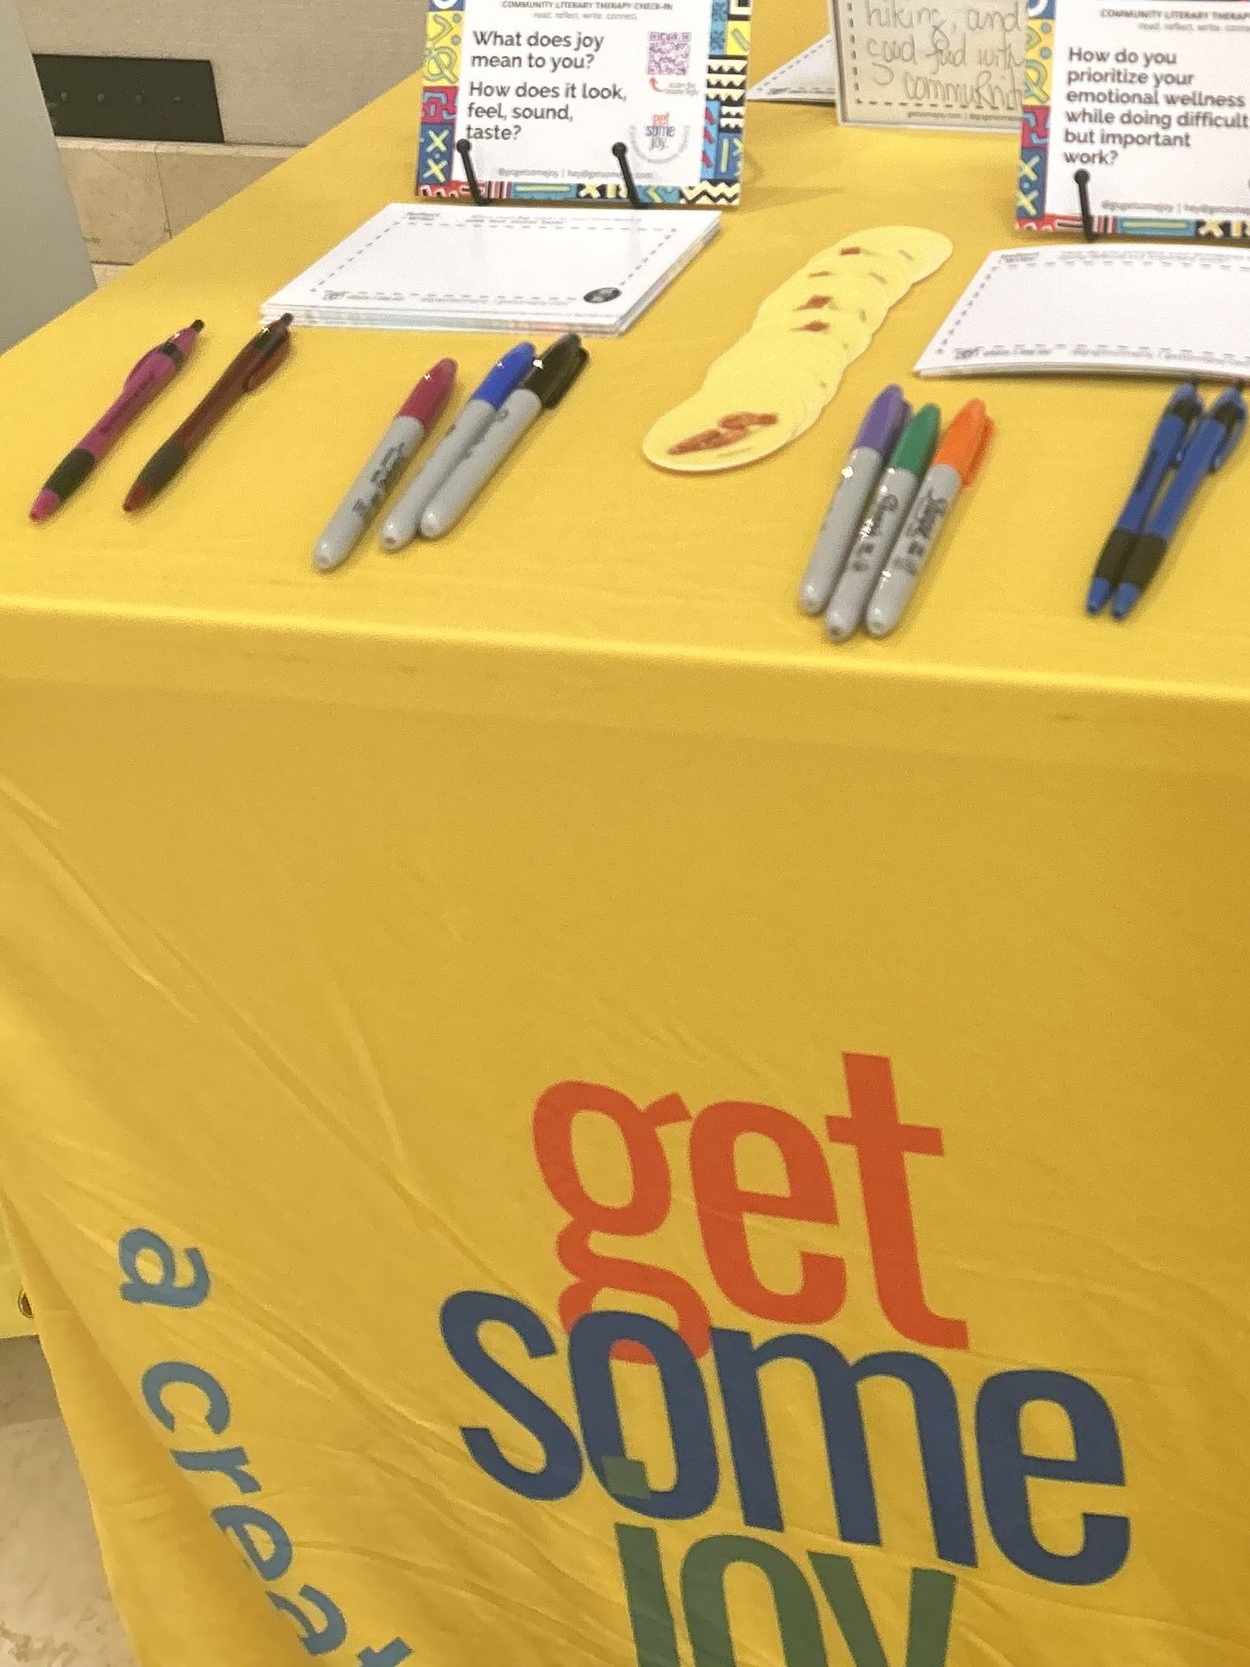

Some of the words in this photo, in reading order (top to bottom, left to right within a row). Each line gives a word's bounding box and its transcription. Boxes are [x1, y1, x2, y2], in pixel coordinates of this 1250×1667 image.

[473, 30, 522, 47] What
[527, 31, 572, 48] does
[574, 32, 604, 51] joy
[471, 54, 522, 68] mean
[528, 53, 546, 68] to
[550, 53, 595, 73] you?
[1068, 47, 1110, 63] How
[1115, 47, 1139, 63] do
[1143, 51, 1177, 67] you
[1067, 67, 1149, 85] prioritize
[1153, 72, 1195, 88] your
[469, 81, 511, 98] How
[515, 82, 560, 98] does
[564, 83, 577, 99] it
[581, 83, 627, 101] look,
[1066, 88, 1158, 105] emotional
[1164, 90, 1246, 108] wellness
[467, 102, 507, 120] feel,
[511, 104, 573, 122] sound,
[1066, 108, 1115, 124] while
[1120, 110, 1172, 129] doing
[1177, 111, 1249, 129] difficult
[466, 124, 522, 141] taste?
[1064, 127, 1096, 144] but
[1100, 130, 1191, 149] important
[1063, 149, 1118, 166] work?
[531, 1049, 970, 1366] get
[118, 1227, 212, 1310] a
[437, 1288, 1133, 1586] some
